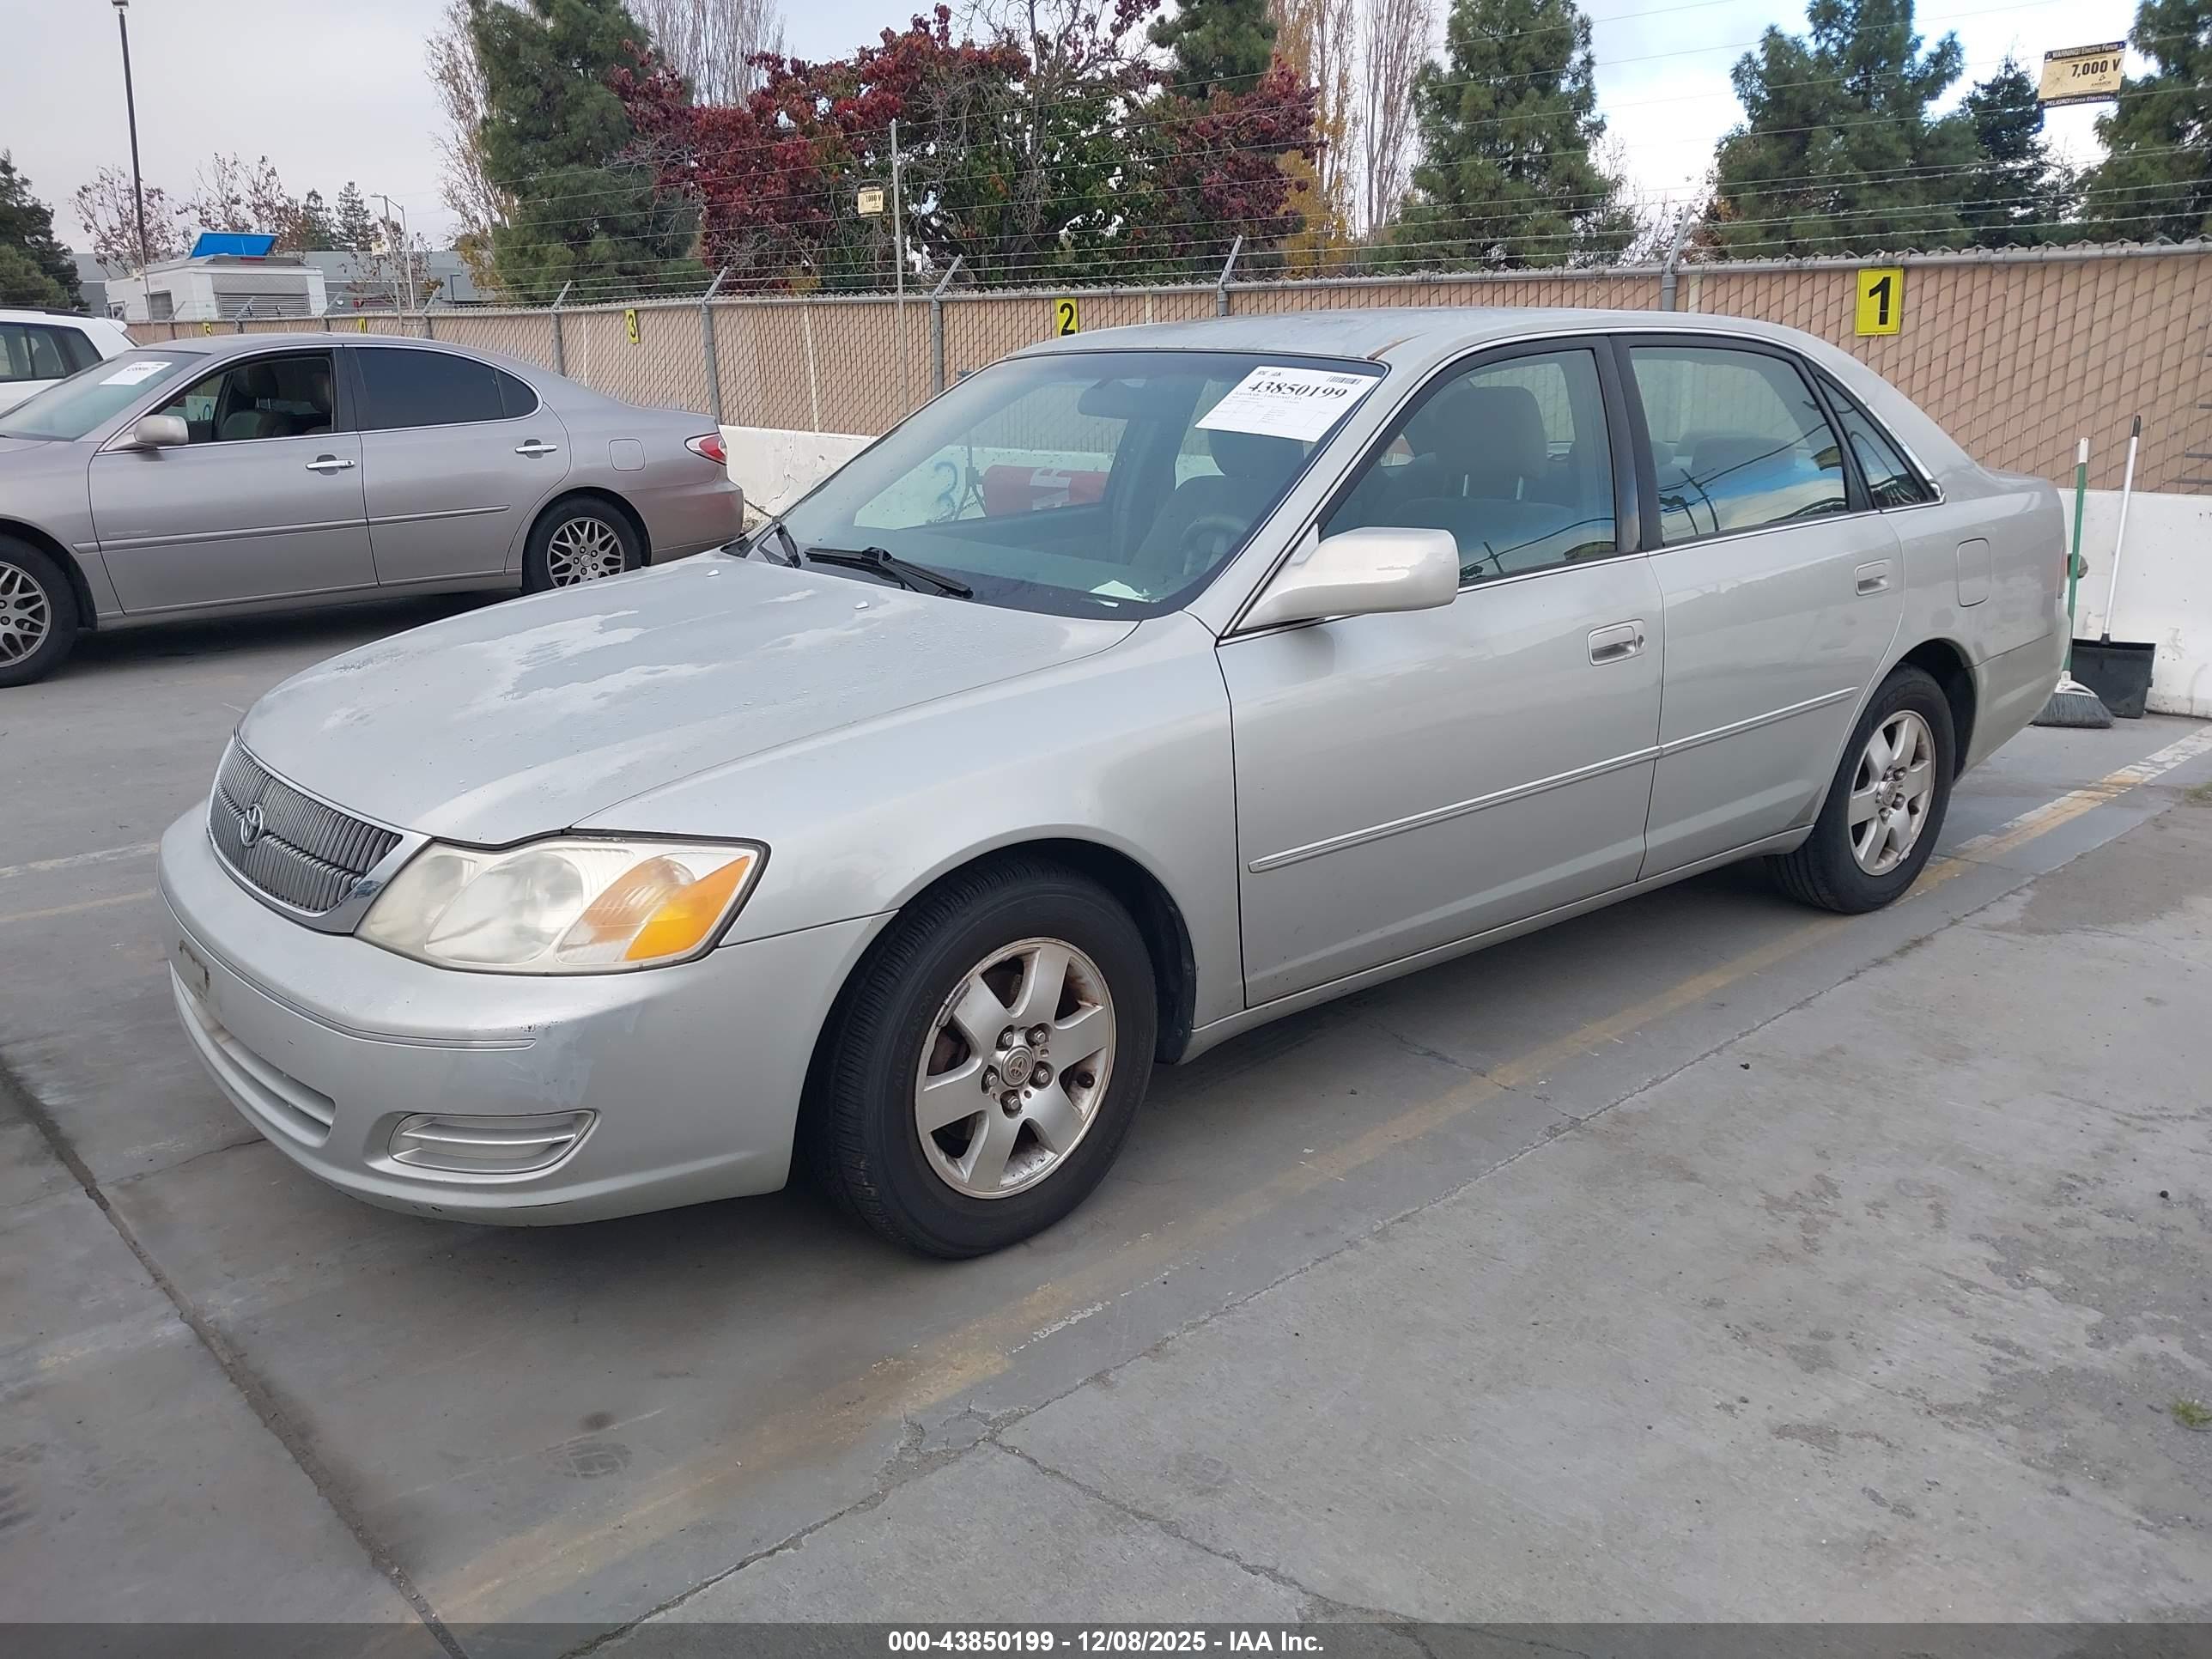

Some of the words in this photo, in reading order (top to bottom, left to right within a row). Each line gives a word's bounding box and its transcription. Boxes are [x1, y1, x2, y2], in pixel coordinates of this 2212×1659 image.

[2071, 60, 2108, 78] 7,000
[2112, 58, 2121, 71] V
[1869, 276, 1891, 325] 1
[629, 314, 636, 338] 3
[1060, 303, 1075, 336] 2
[1249, 380, 1347, 399] 43850199
